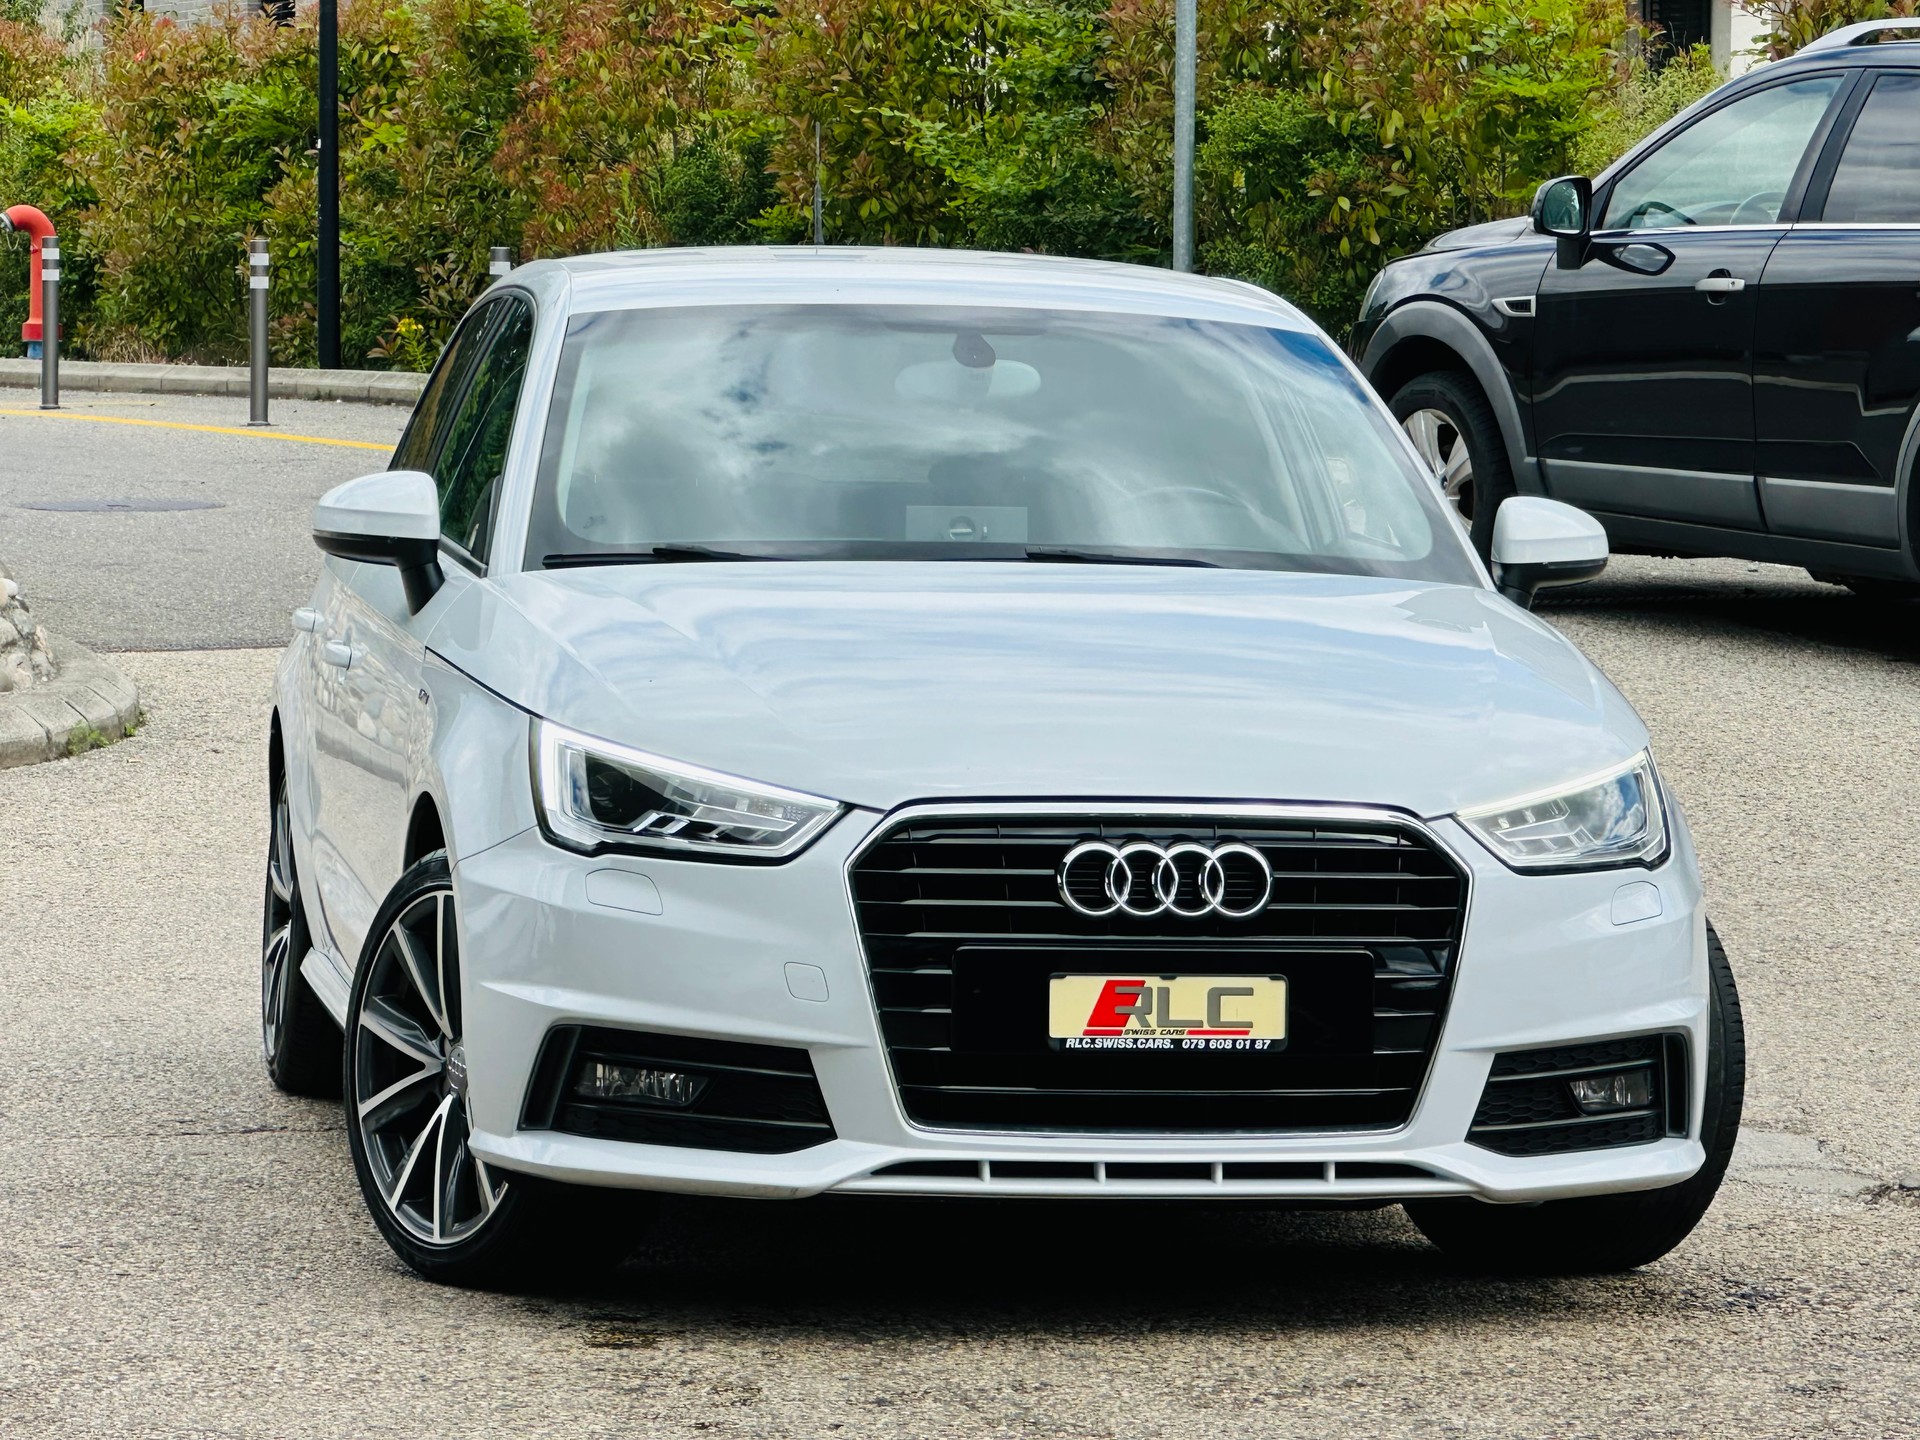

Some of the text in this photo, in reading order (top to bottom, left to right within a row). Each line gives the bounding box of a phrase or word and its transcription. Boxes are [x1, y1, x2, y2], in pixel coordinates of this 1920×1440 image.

[1114, 987, 1254, 1028] RLC
[1065, 1038, 1271, 1049] RLC.SWISS.CARS. 079 608 01 87
